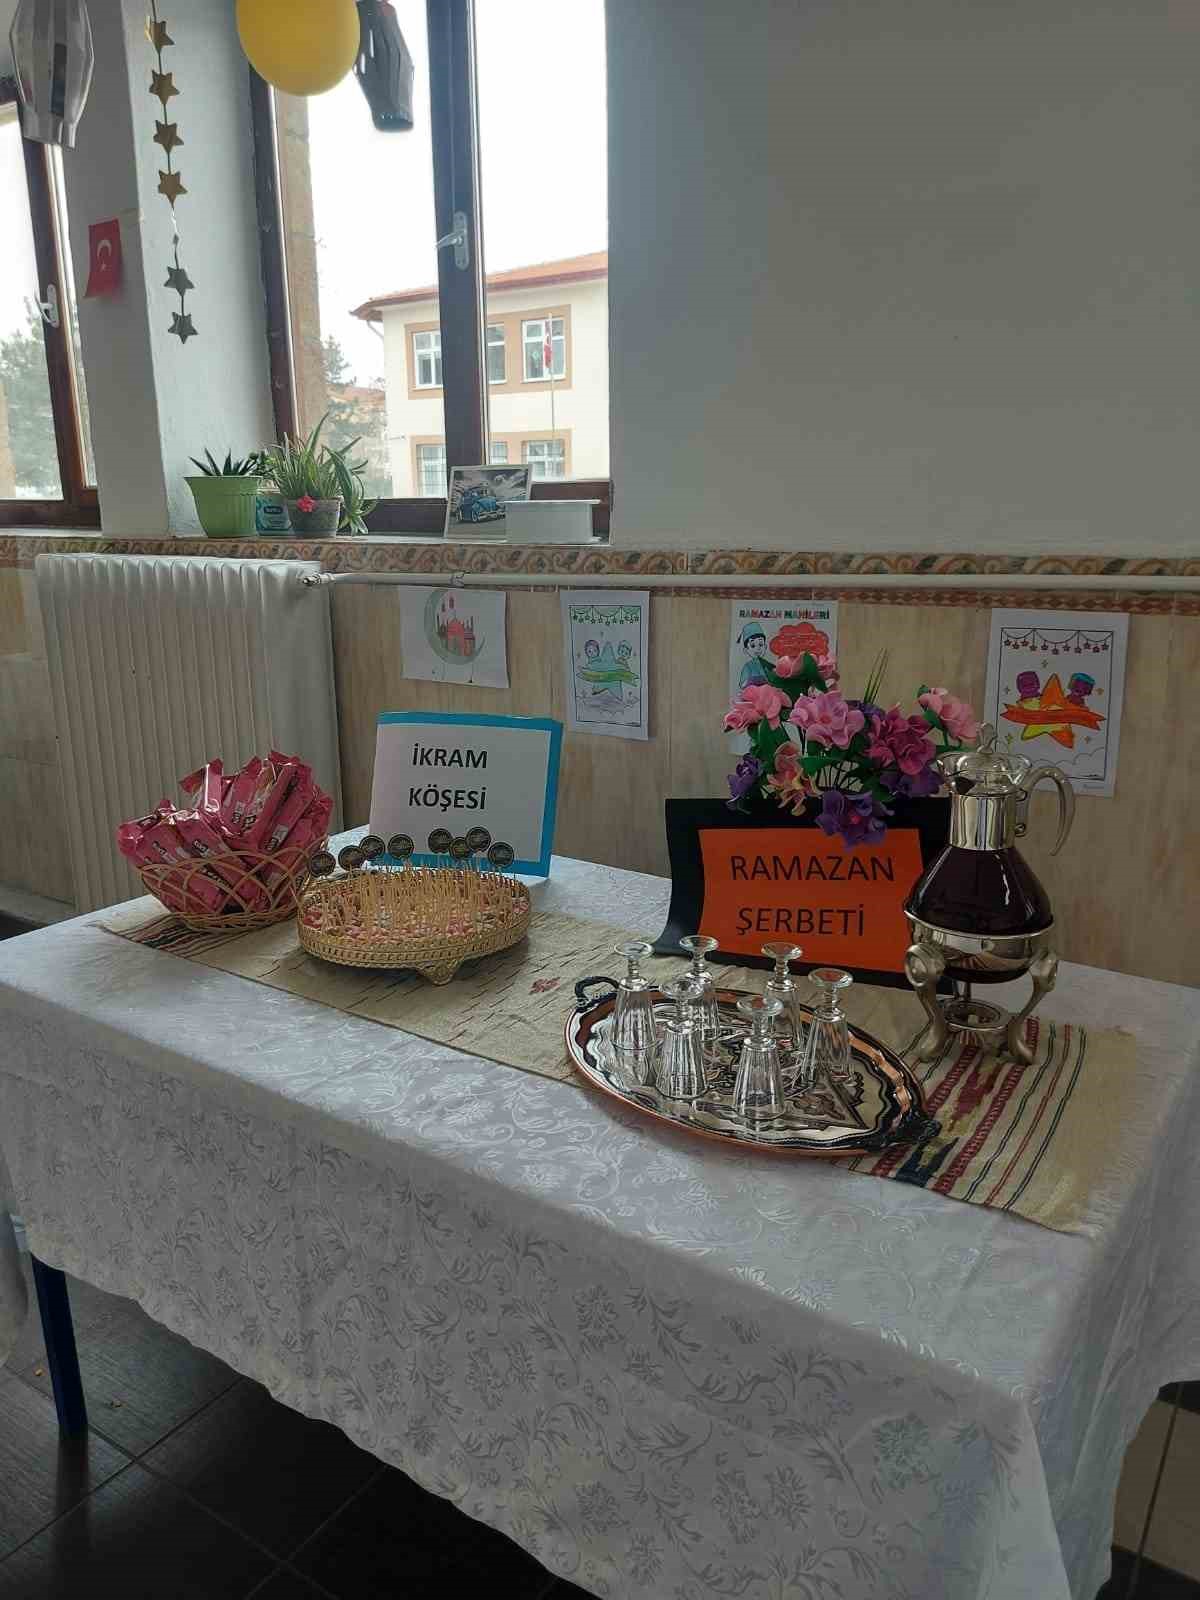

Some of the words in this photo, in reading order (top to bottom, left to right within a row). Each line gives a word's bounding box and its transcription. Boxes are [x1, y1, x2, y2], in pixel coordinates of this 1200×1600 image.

[739, 609, 783, 618] RAMAZAN
[412, 742, 488, 769] İKRAM
[408, 783, 487, 812] KÖŞESİ
[730, 855, 895, 881] RAMAZAN
[735, 903, 864, 937] ŞERBETİ
